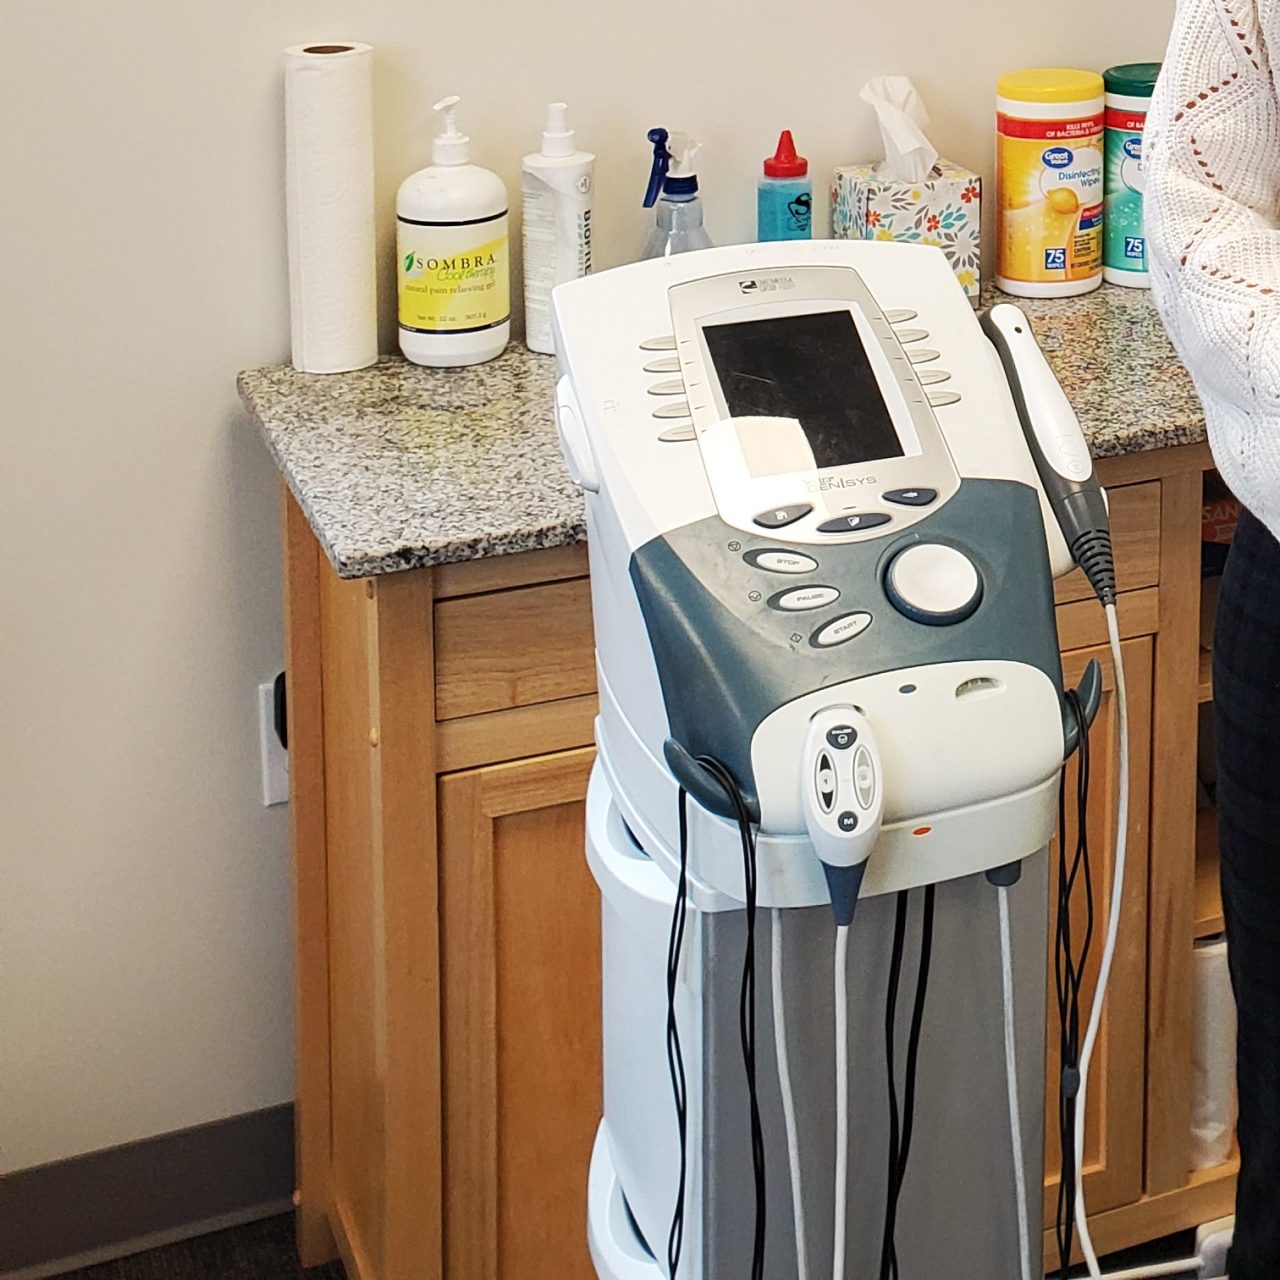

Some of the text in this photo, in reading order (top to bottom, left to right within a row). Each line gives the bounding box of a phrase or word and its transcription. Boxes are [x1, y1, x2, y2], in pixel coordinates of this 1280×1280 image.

[1045, 151, 1069, 162] Great
[1127, 238, 1143, 251] 75
[416, 253, 496, 271] SOMBRA
[1047, 250, 1064, 263] 75
[833, 620, 858, 635] START
[843, 817, 854, 825] M
